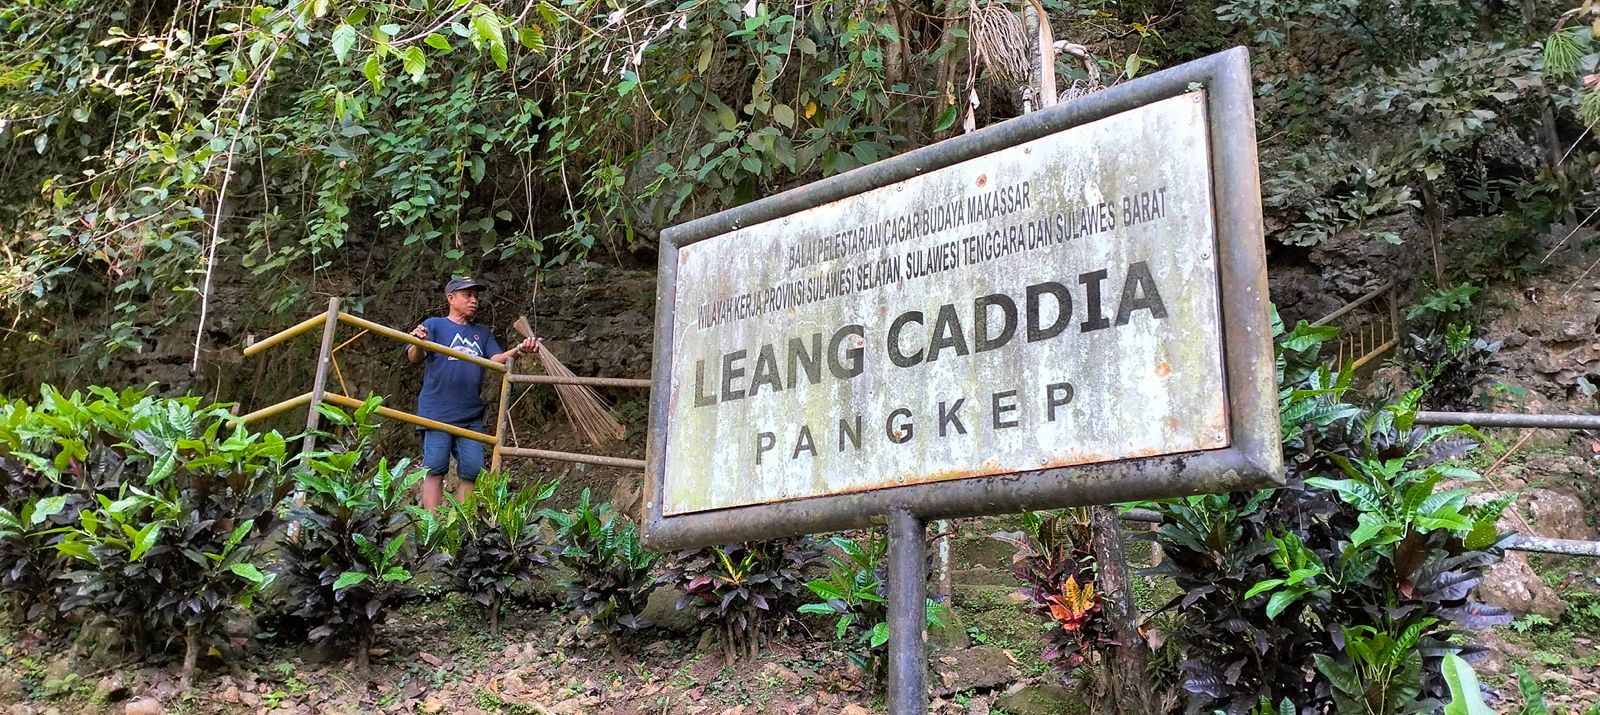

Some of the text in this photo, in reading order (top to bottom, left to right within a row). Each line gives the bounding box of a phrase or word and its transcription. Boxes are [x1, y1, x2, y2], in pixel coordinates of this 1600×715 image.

[697, 297, 733, 330] WILAYAH
[734, 292, 762, 321] KERJA
[763, 279, 805, 314] PROVINSI
[806, 267, 855, 304] SULAWESI
[856, 255, 904, 291] SELATAN,
[905, 244, 960, 280] SULAWESI
[962, 226, 1026, 266] TENGGARA
[1028, 218, 1053, 251] DAN
[1122, 186, 1167, 227] BARAT
[788, 181, 1031, 271] BALAI PELESTARIAN CAGAR BUDAYA MAKASSAR
[694, 260, 1169, 408] LEANG CADDIA
[755, 382, 1075, 465] PANGKEP
